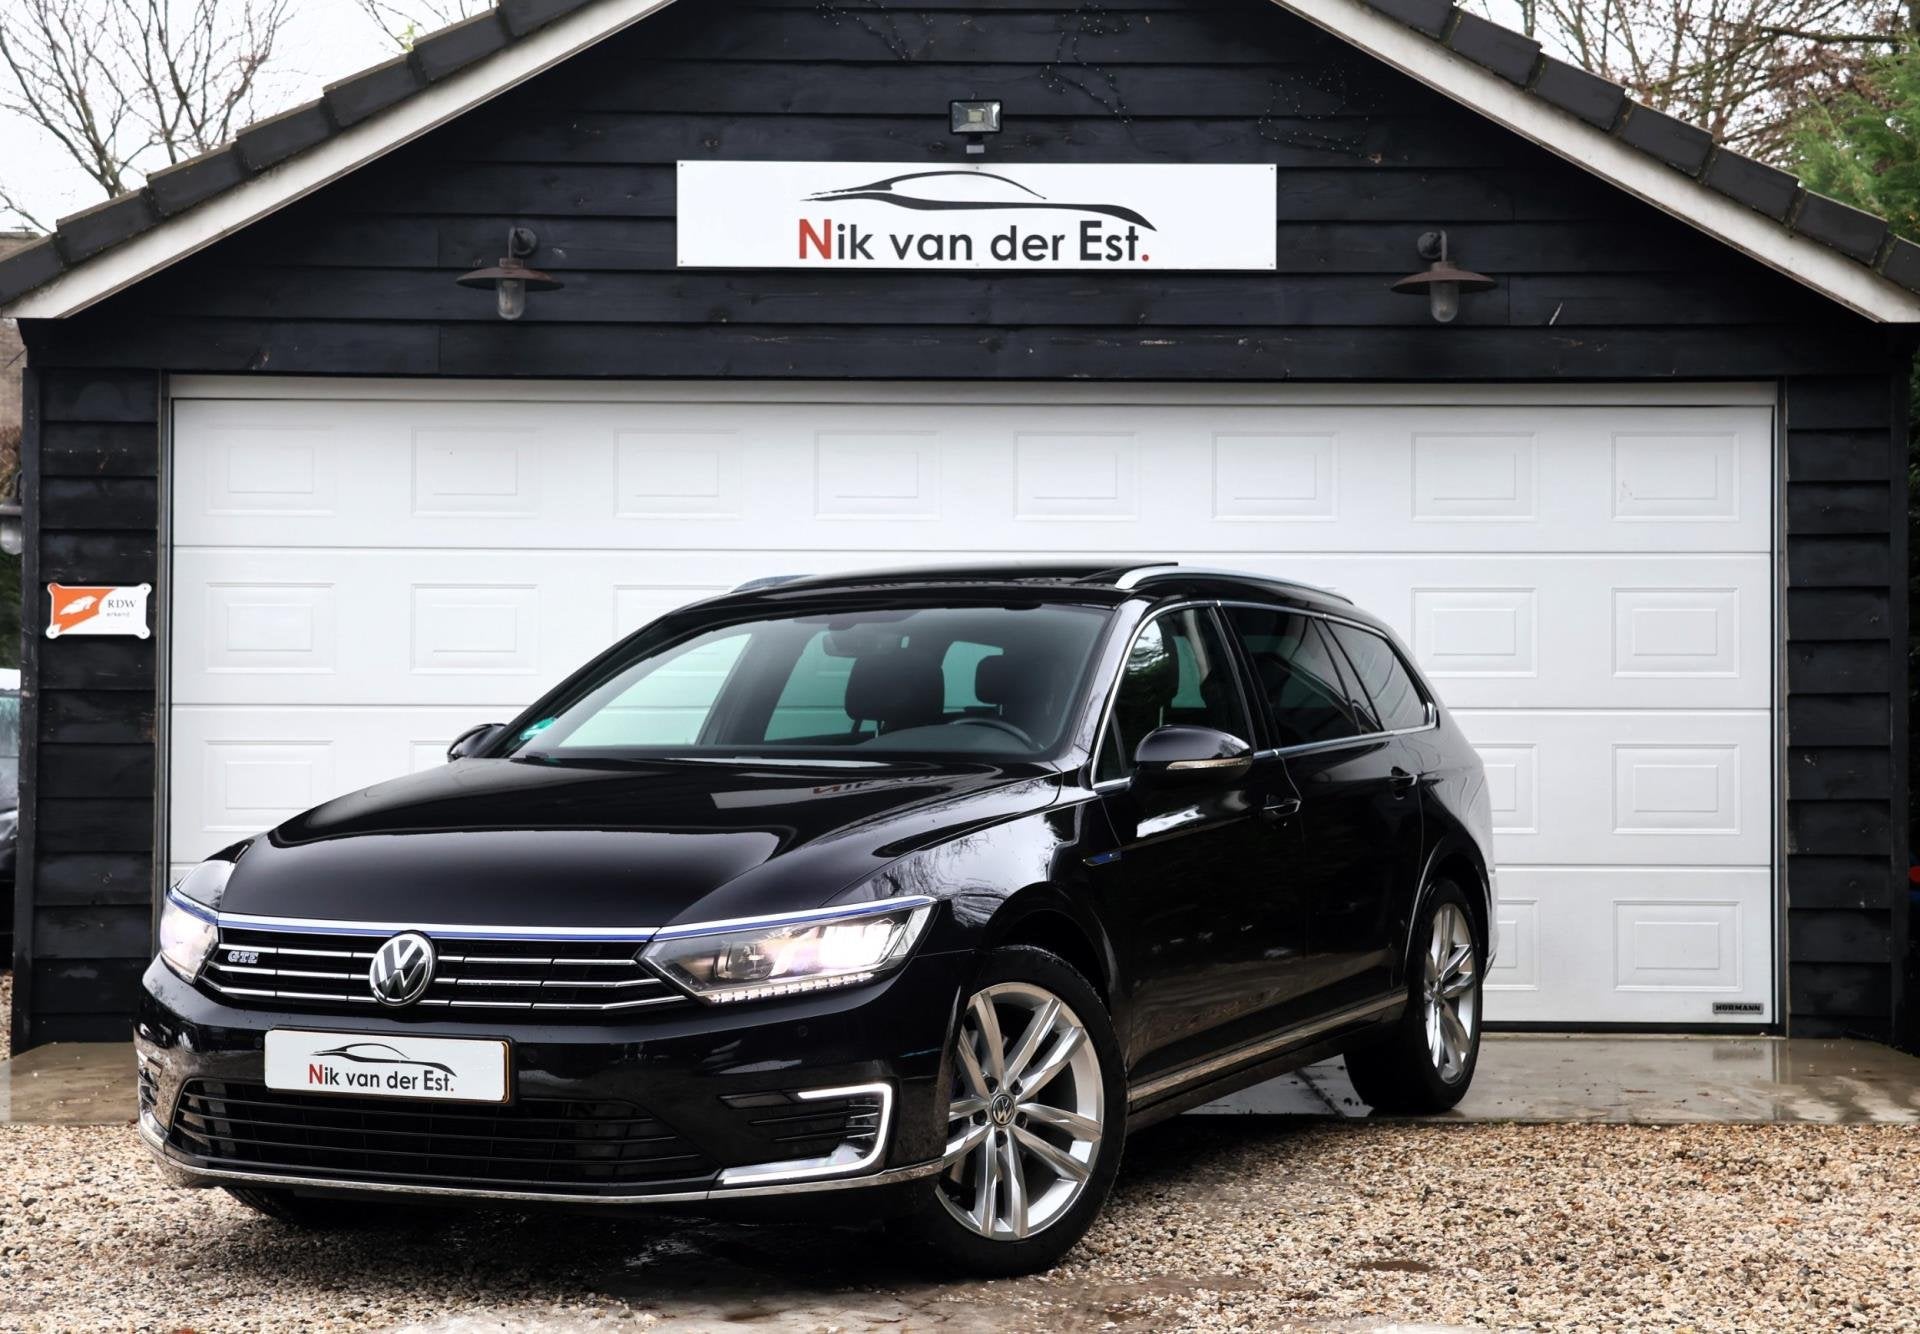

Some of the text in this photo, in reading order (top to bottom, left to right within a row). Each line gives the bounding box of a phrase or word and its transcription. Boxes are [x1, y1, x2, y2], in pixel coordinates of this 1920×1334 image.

[799, 218, 1150, 262] Nik van der Est.
[107, 599, 137, 609] RDW
[227, 950, 259, 964] GTE
[309, 1064, 455, 1092] Nik van der Est.
